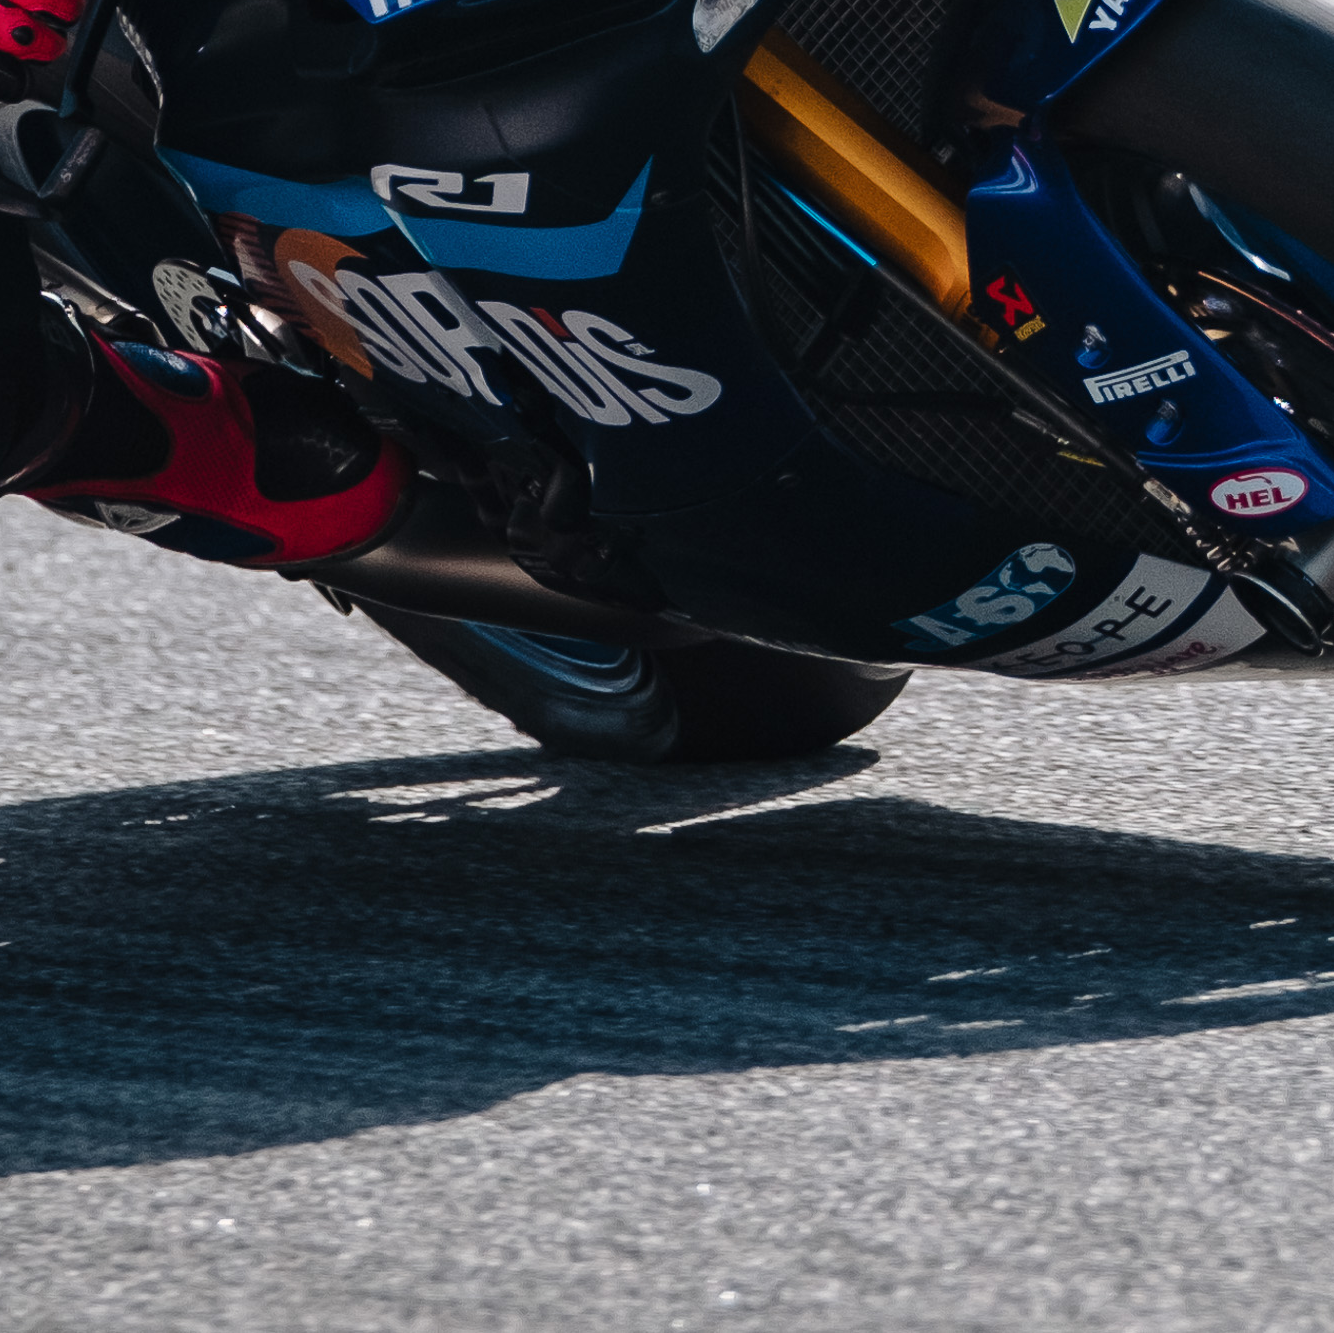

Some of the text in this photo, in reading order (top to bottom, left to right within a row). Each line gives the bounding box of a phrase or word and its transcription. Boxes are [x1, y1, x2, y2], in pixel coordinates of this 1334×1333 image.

[370, 163, 530, 214] R1
[1083, 350, 1197, 404] PIRELLI
[1224, 486, 1293, 510] HEL
